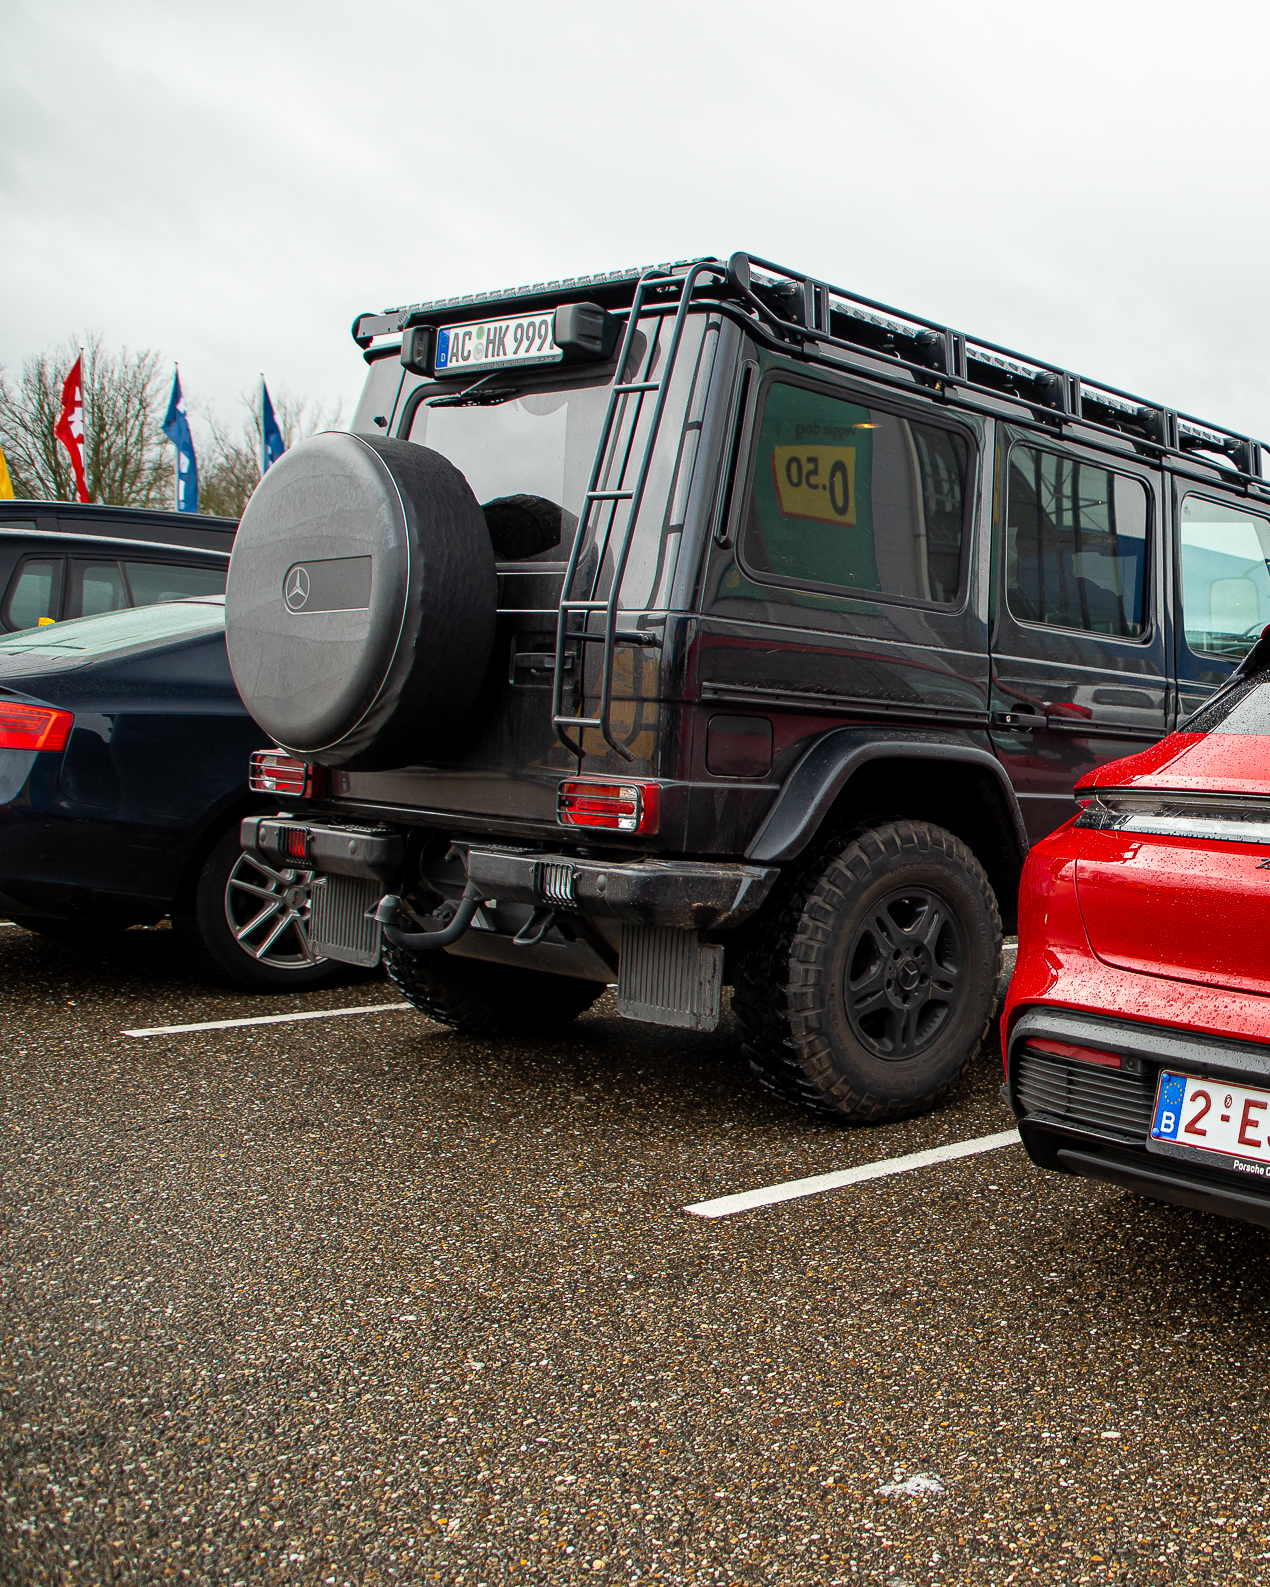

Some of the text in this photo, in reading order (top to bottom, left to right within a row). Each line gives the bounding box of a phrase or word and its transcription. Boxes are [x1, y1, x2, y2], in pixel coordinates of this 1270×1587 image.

[449, 318, 555, 363] AC HK 999
[1160, 1111, 1175, 1133] B
[1233, 1159, 1264, 1176] Porsche
